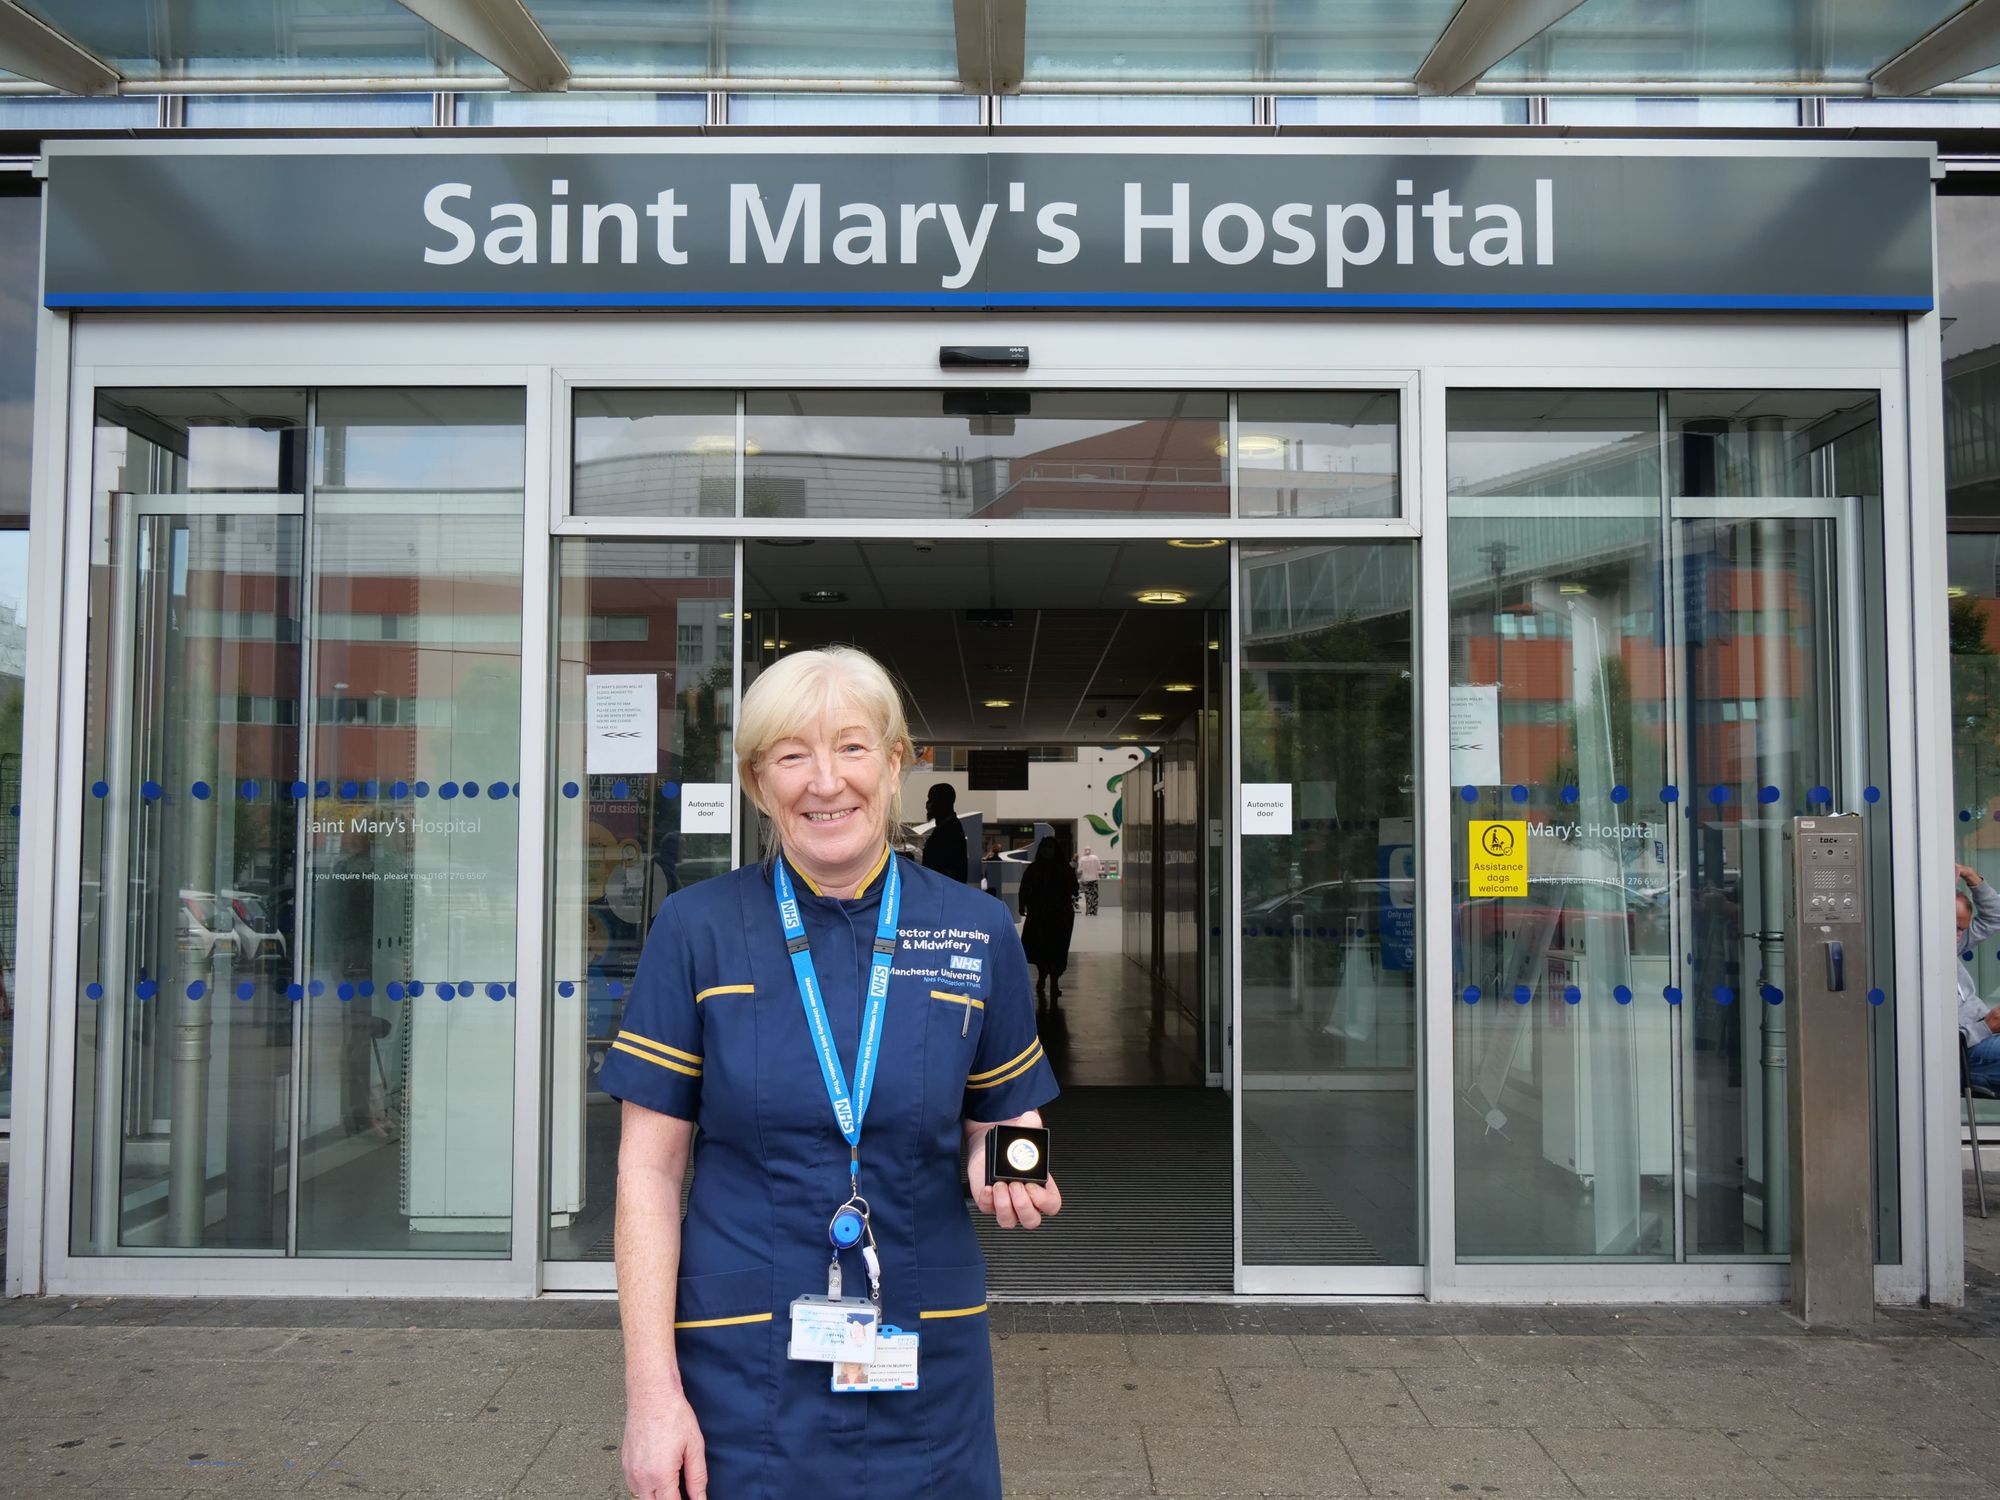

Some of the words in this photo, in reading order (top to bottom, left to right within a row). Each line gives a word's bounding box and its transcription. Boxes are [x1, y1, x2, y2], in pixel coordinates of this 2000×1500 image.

[420, 179, 689, 268] Saint
[728, 182, 1082, 289] Mary's
[1124, 178, 1553, 289] Hospital
[351, 818, 406, 836] Mary's
[412, 818, 481, 836] Hospital
[1527, 821, 1582, 841] Mary's
[1588, 822, 1658, 841] Hospital
[1473, 862, 1524, 871] Assistance
[315, 874, 330, 882] you
[332, 872, 360, 882] require
[362, 872, 382, 882] help,
[384, 872, 409, 882] please
[1487, 873, 1510, 883] dogs
[1478, 884, 1518, 893] welcome
[782, 900, 798, 928] NHS
[896, 929, 931, 938] rector
[934, 930, 946, 938] of
[948, 929, 990, 944] Nursing
[902, 940, 912, 949] &
[914, 940, 971, 953] Midwifery
[951, 956, 982, 972] NHS
[872, 966, 887, 996] NHS
[890, 968, 938, 976] Manchester
[941, 968, 981, 983] University
[805, 977, 816, 1007] Manchester
[812, 1008, 823, 1034] University
[833, 1079, 842, 1095] Trust
[860, 1060, 870, 1089] University
[836, 1100, 854, 1132] NHS
